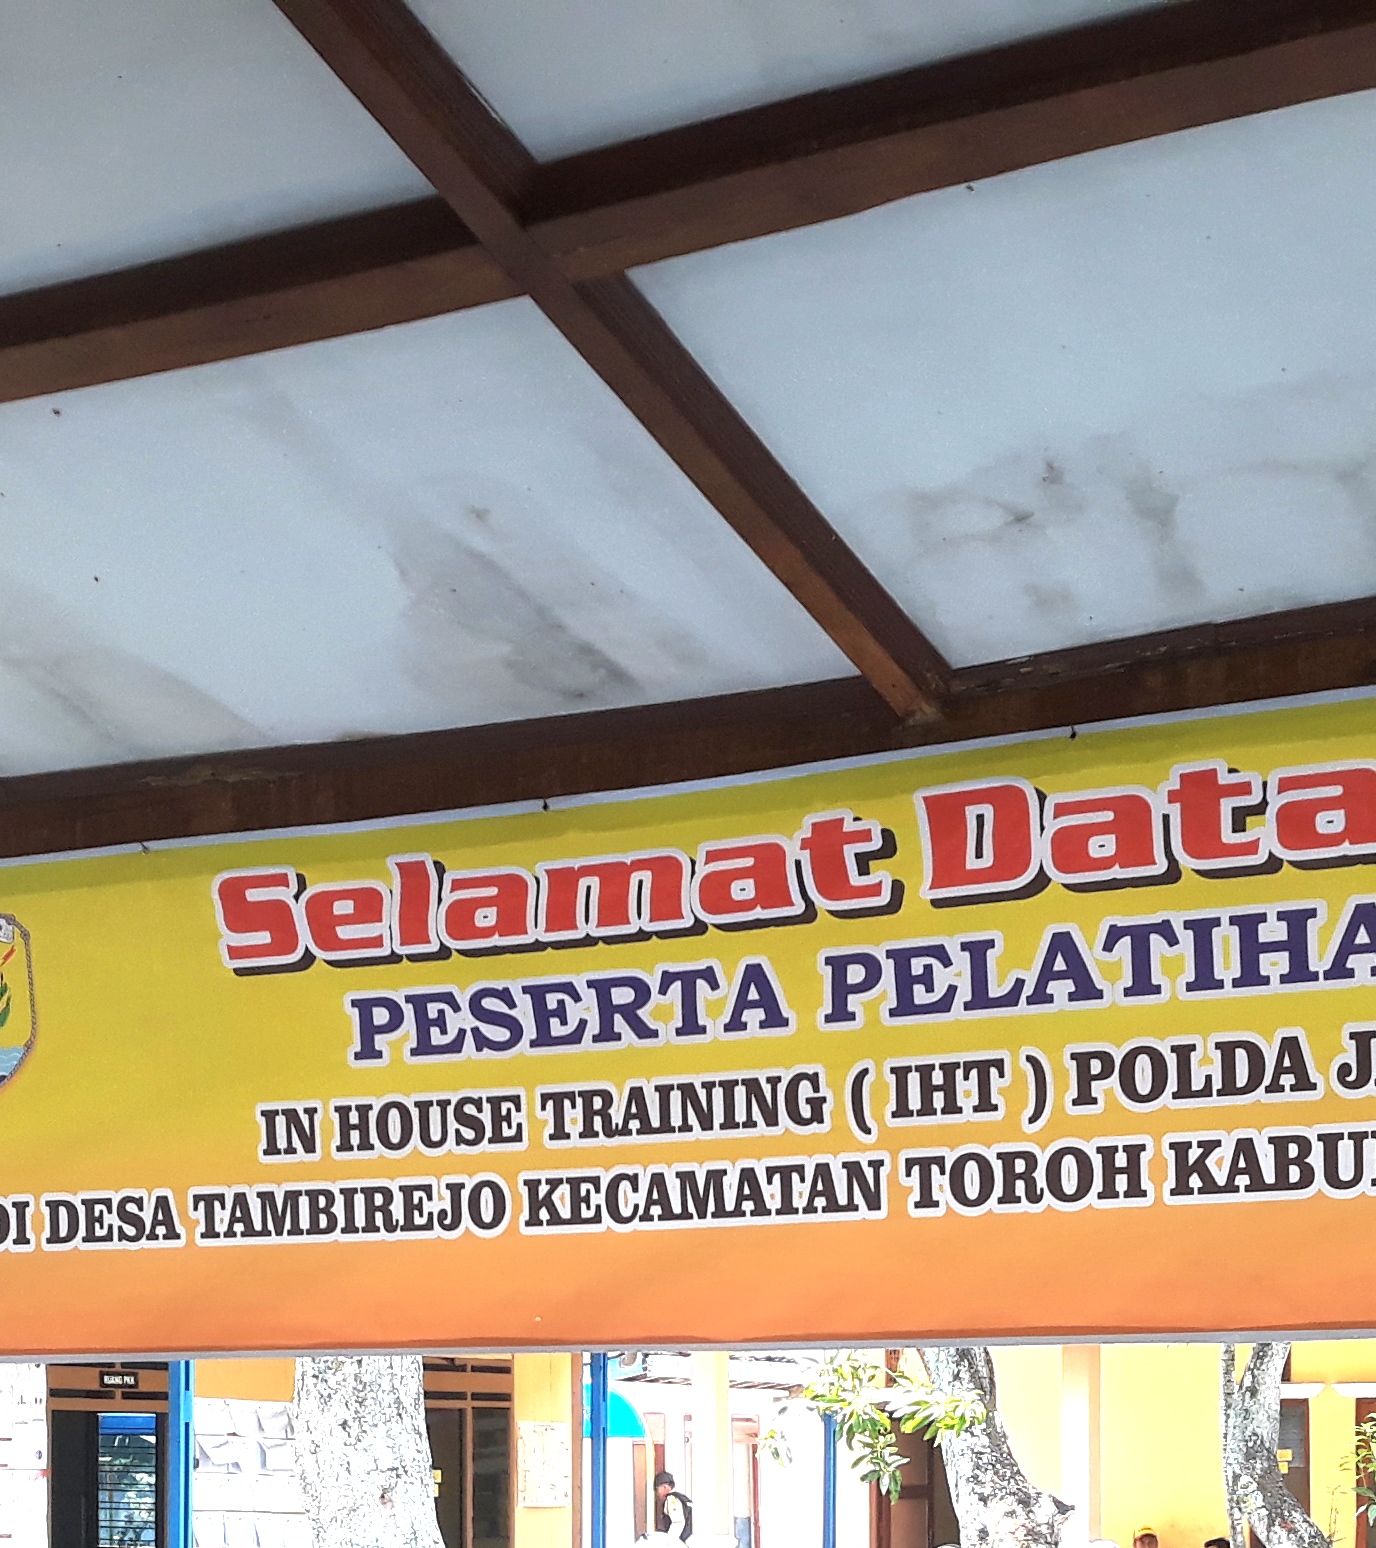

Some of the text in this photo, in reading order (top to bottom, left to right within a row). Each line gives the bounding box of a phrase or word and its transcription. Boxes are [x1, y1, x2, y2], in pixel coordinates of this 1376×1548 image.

[215, 812, 894, 966] Selamat
[349, 962, 790, 1061] PESERTA
[259, 1106, 319, 1157] IN
[334, 1094, 524, 1153] HOUSE
[540, 1070, 828, 1142] TRAINING
[1070, 1035, 1318, 1107] POLDA
[43, 1193, 181, 1245] DESA
[192, 1178, 507, 1239] TAMBIREJO
[523, 1157, 887, 1228] KECAMATAN
[904, 1143, 1148, 1210] TOROH
